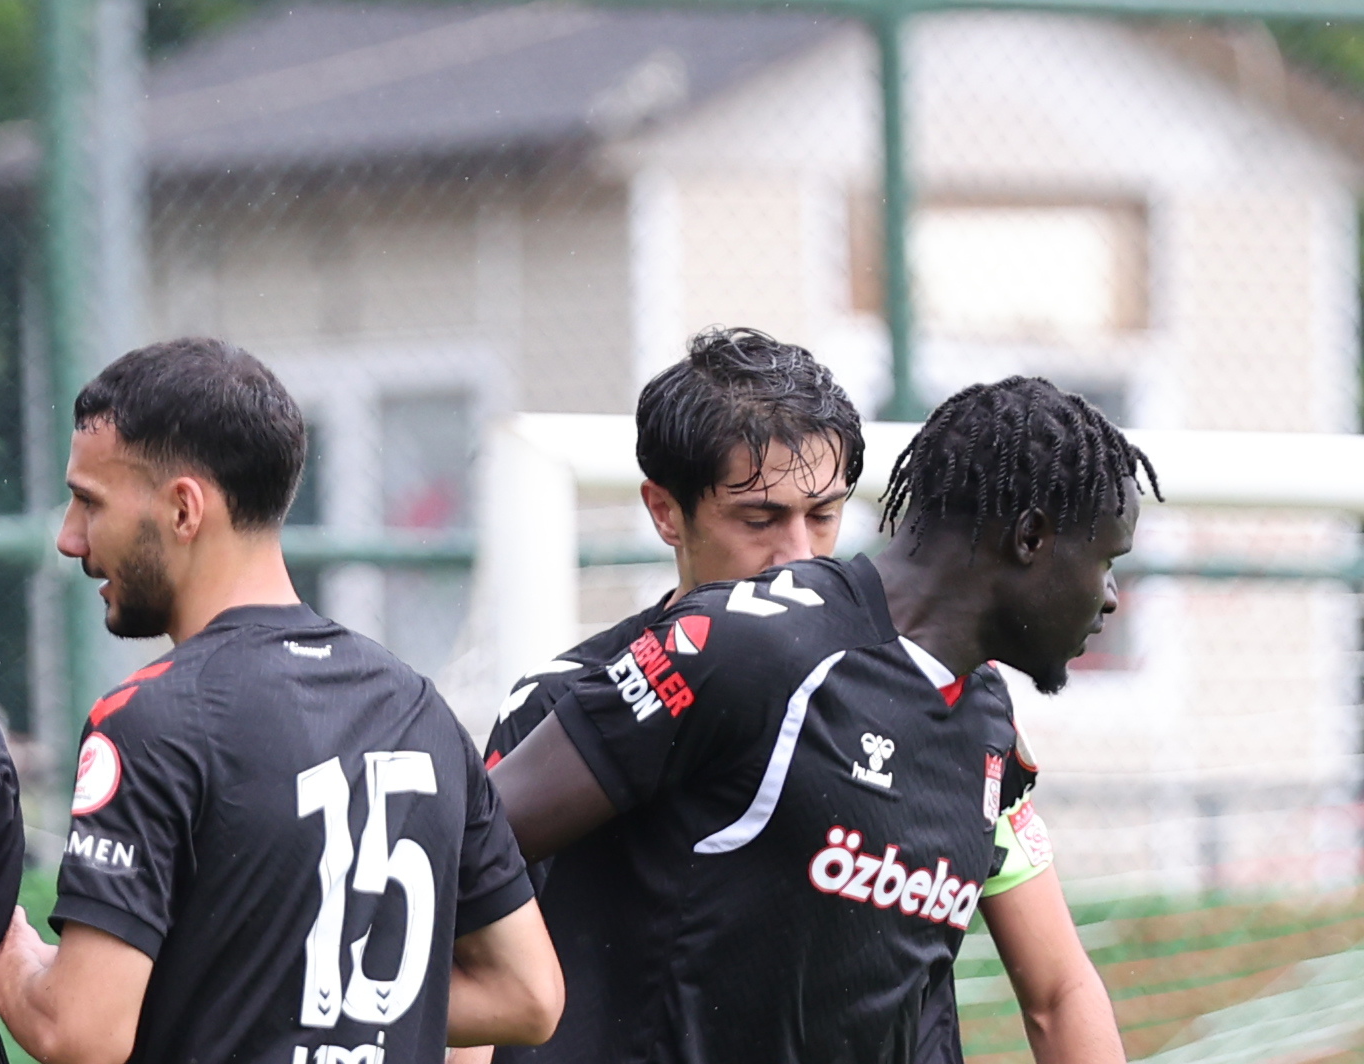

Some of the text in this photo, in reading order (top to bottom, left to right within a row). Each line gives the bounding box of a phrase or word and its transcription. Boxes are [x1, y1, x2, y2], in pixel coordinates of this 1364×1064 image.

[607, 652, 664, 723] ETON
[63, 830, 135, 868] MEN
[296, 751, 438, 1029] 15
